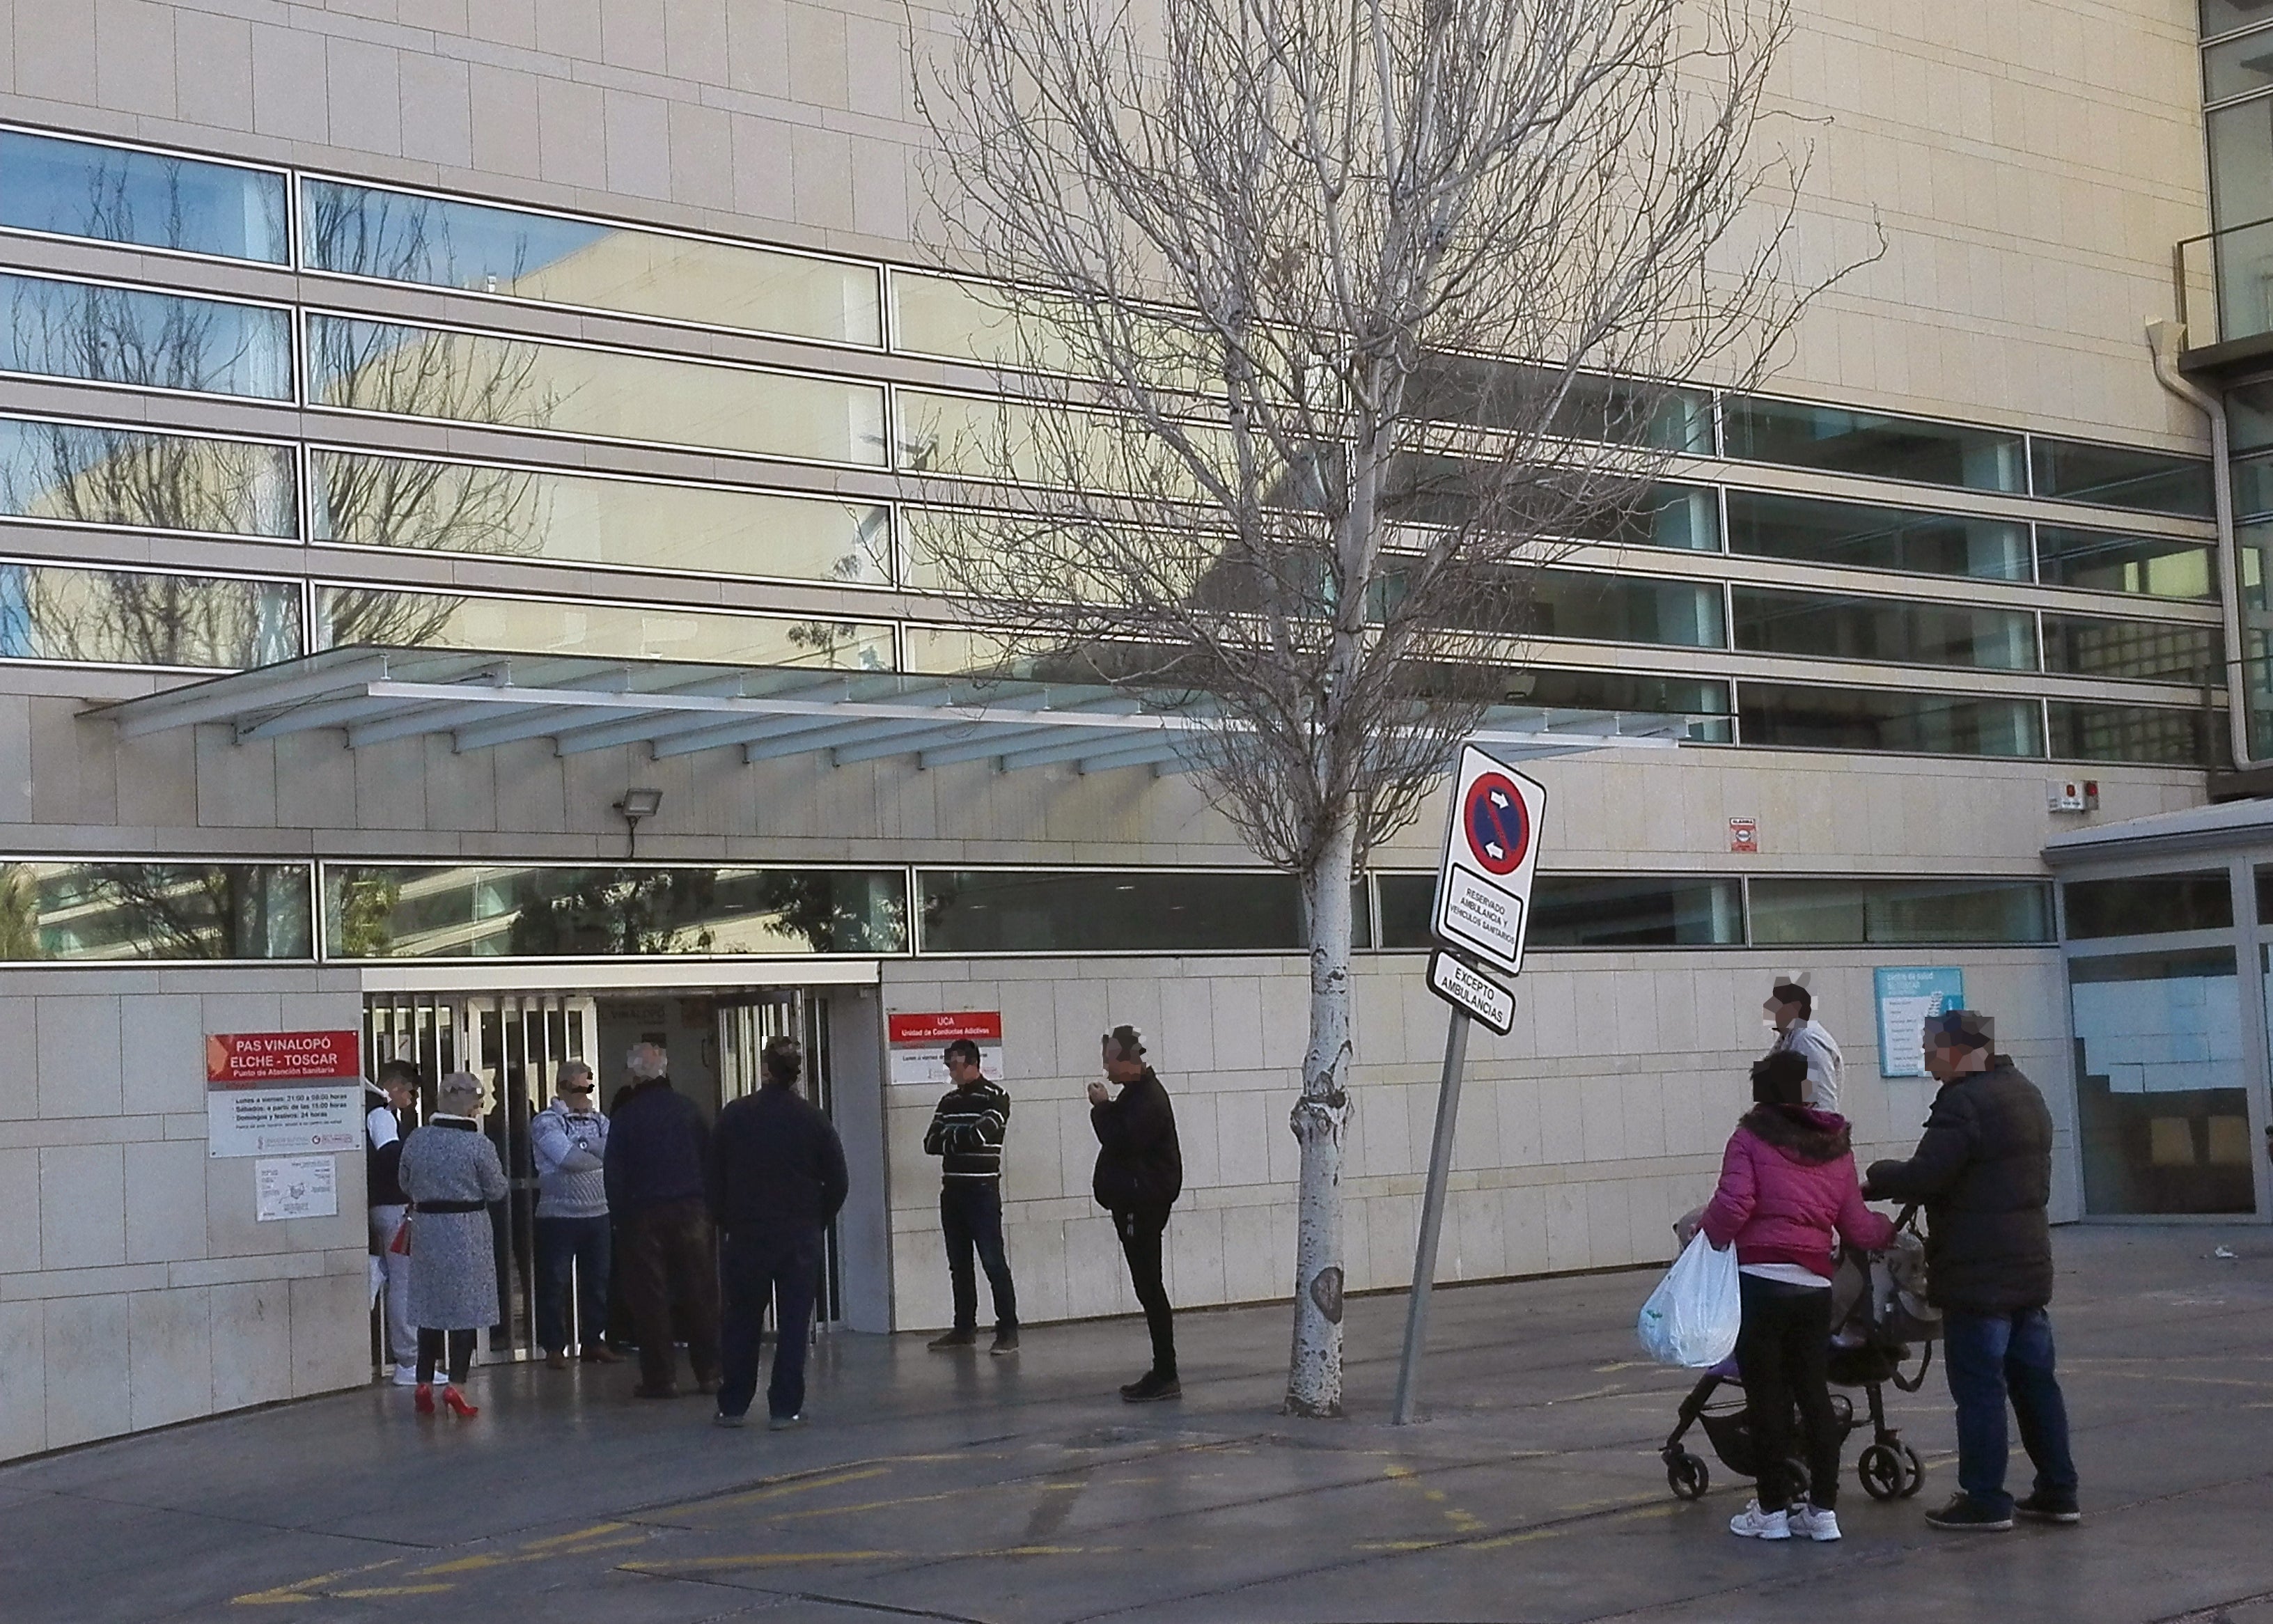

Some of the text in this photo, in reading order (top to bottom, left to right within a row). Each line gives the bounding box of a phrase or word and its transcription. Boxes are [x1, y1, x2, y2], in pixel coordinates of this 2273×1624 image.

[1460, 897, 1501, 925] AMBULANCIA
[1466, 888, 1506, 915] RESERVADO
[1482, 921, 1515, 944] SANITARIOS
[1455, 967, 1494, 1001] EXCEPTO
[1442, 976, 1503, 1023] AMBULANCIAS
[937, 1017, 955, 1026] UCA
[236, 1036, 331, 1052] PAS VINALOPÓ
[231, 1056, 274, 1068] ELCHE
[284, 1054, 338, 1066] TOSCAR
[268, 1067, 301, 1075] Atención
